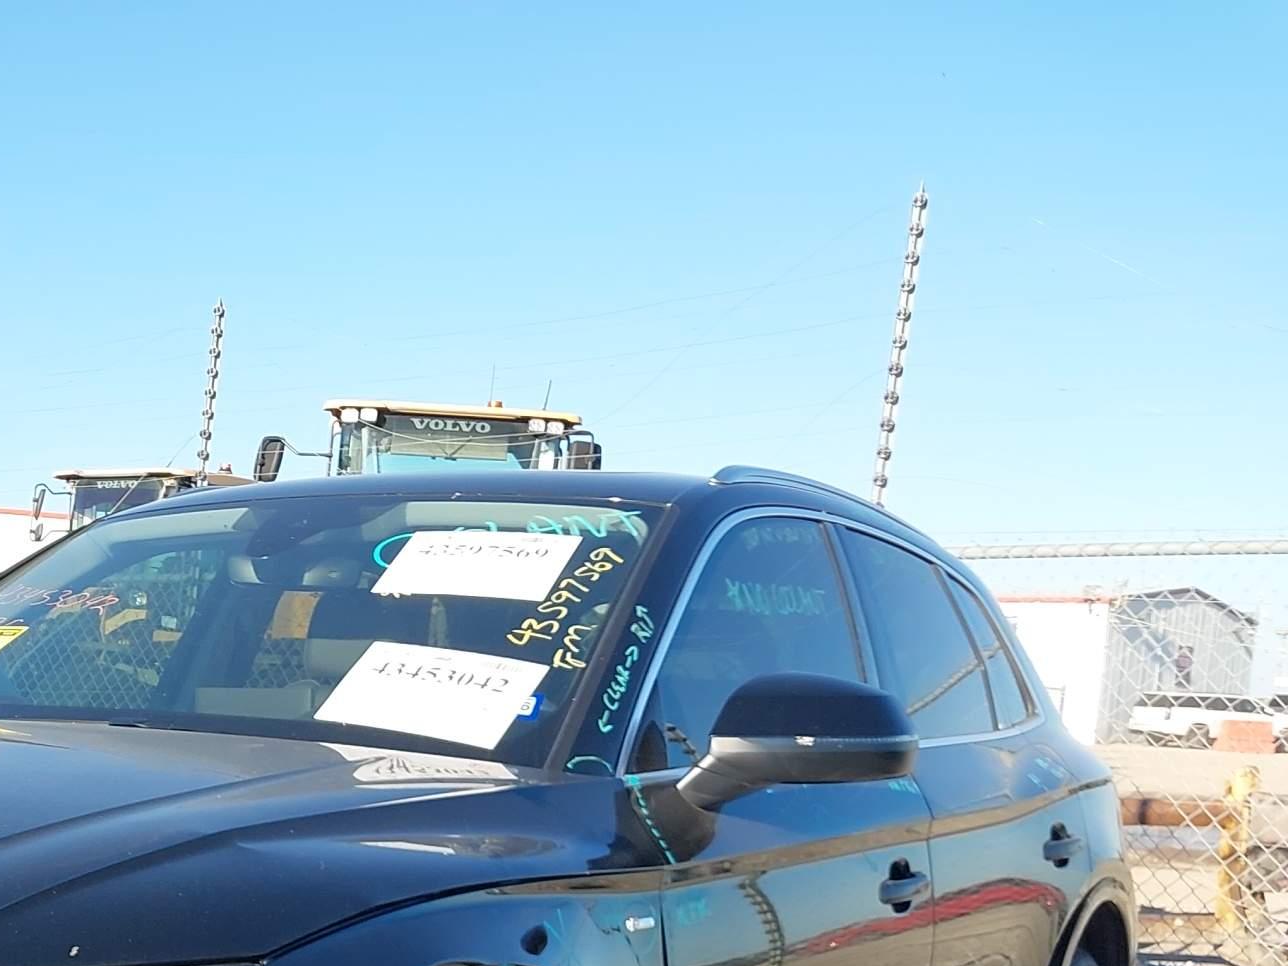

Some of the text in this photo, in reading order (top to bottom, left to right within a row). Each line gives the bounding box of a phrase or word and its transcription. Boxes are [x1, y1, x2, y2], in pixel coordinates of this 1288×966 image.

[409, 417, 491, 434] VOLVO
[96, 480, 137, 489] VOLVO
[418, 544, 549, 558] 43597569
[506, 547, 624, 645] 43597569
[371, 662, 509, 693] 43453042
